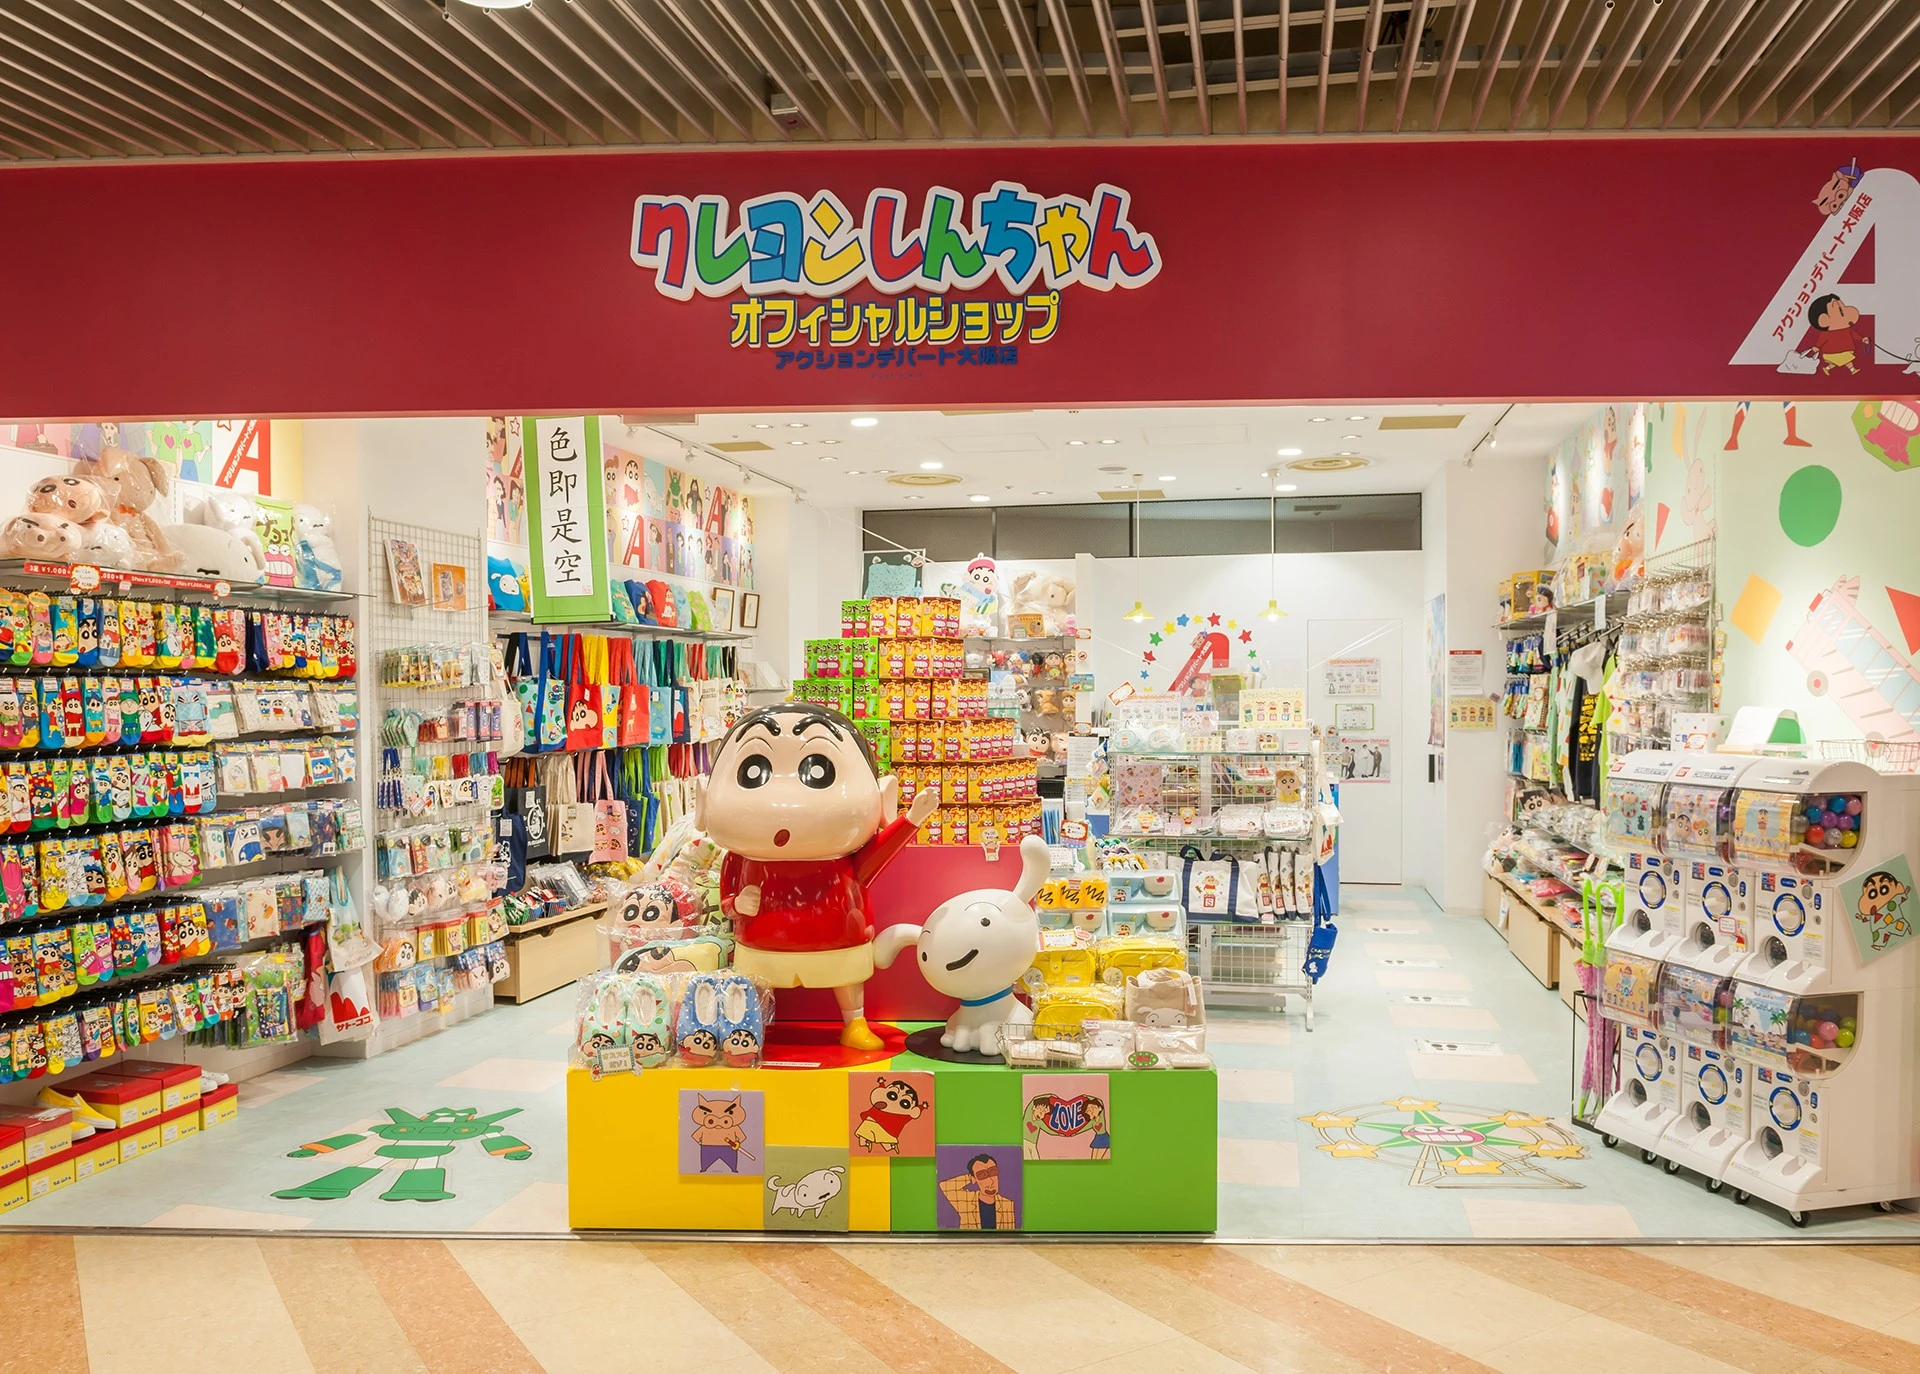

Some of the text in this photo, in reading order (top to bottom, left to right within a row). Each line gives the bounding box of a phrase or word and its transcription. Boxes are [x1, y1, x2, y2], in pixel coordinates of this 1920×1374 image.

[635, 187, 1157, 288] クレヨンしんちゃん
[1772, 192, 1873, 342] アクションデパート大阪店
[729, 293, 1061, 347] オフィシャルショップ
[775, 346, 1018, 370] アクションデパート大阪店
[548, 426, 583, 584] 色即是空
[1049, 1100, 1086, 1132] LOVE
